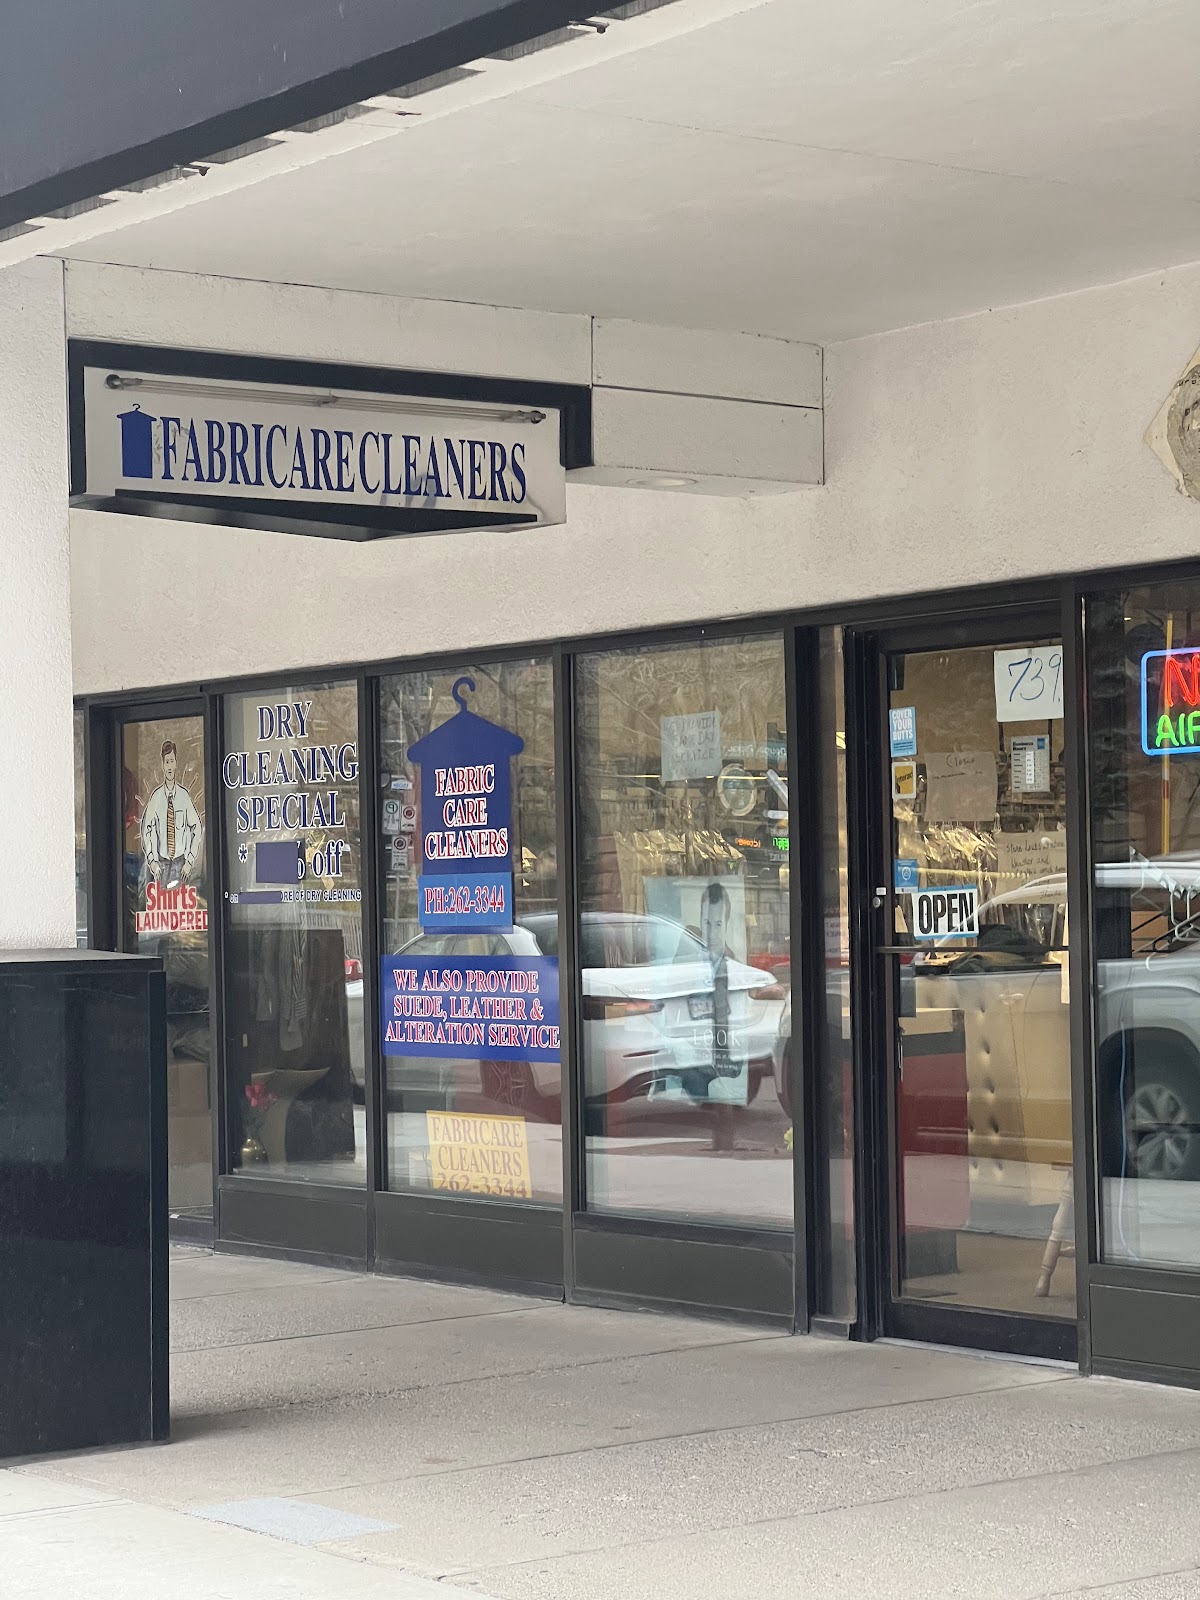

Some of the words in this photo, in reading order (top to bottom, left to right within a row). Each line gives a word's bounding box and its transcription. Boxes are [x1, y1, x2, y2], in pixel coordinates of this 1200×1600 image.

[256, 700, 313, 742] DRY
[892, 708, 912, 719] COVER
[893, 719, 913, 731] YOUR
[893, 729, 913, 741] BUTTS
[222, 742, 359, 790] CLEANING
[435, 764, 495, 797] FABRIC
[237, 791, 346, 833] SPECIAL
[443, 797, 487, 827] CARE
[312, 839, 344, 878] off
[424, 827, 509, 860] CLEANERS
[145, 881, 197, 912] Shirts
[295, 890, 304, 901] OF
[306, 889, 321, 901] DRY
[323, 888, 361, 902] CLEANING
[135, 909, 209, 932] LAUNDERED
[918, 892, 975, 935] OPEN
[393, 969, 418, 991] WE
[421, 970, 463, 993] ALSO
[465, 970, 539, 994] PROVIDE
[393, 995, 448, 1023] SUEDE,
[450, 996, 526, 1020] LEATHER
[530, 998, 544, 1020] &
[384, 1020, 486, 1046] ALTERATION
[488, 1024, 561, 1049] SERVICE
[692, 1028, 741, 1047] LOOK
[430, 1117, 523, 1148] FABRICARE
[437, 1145, 523, 1177] CLEANERS
[436, 1172, 528, 1198] 262-3344
